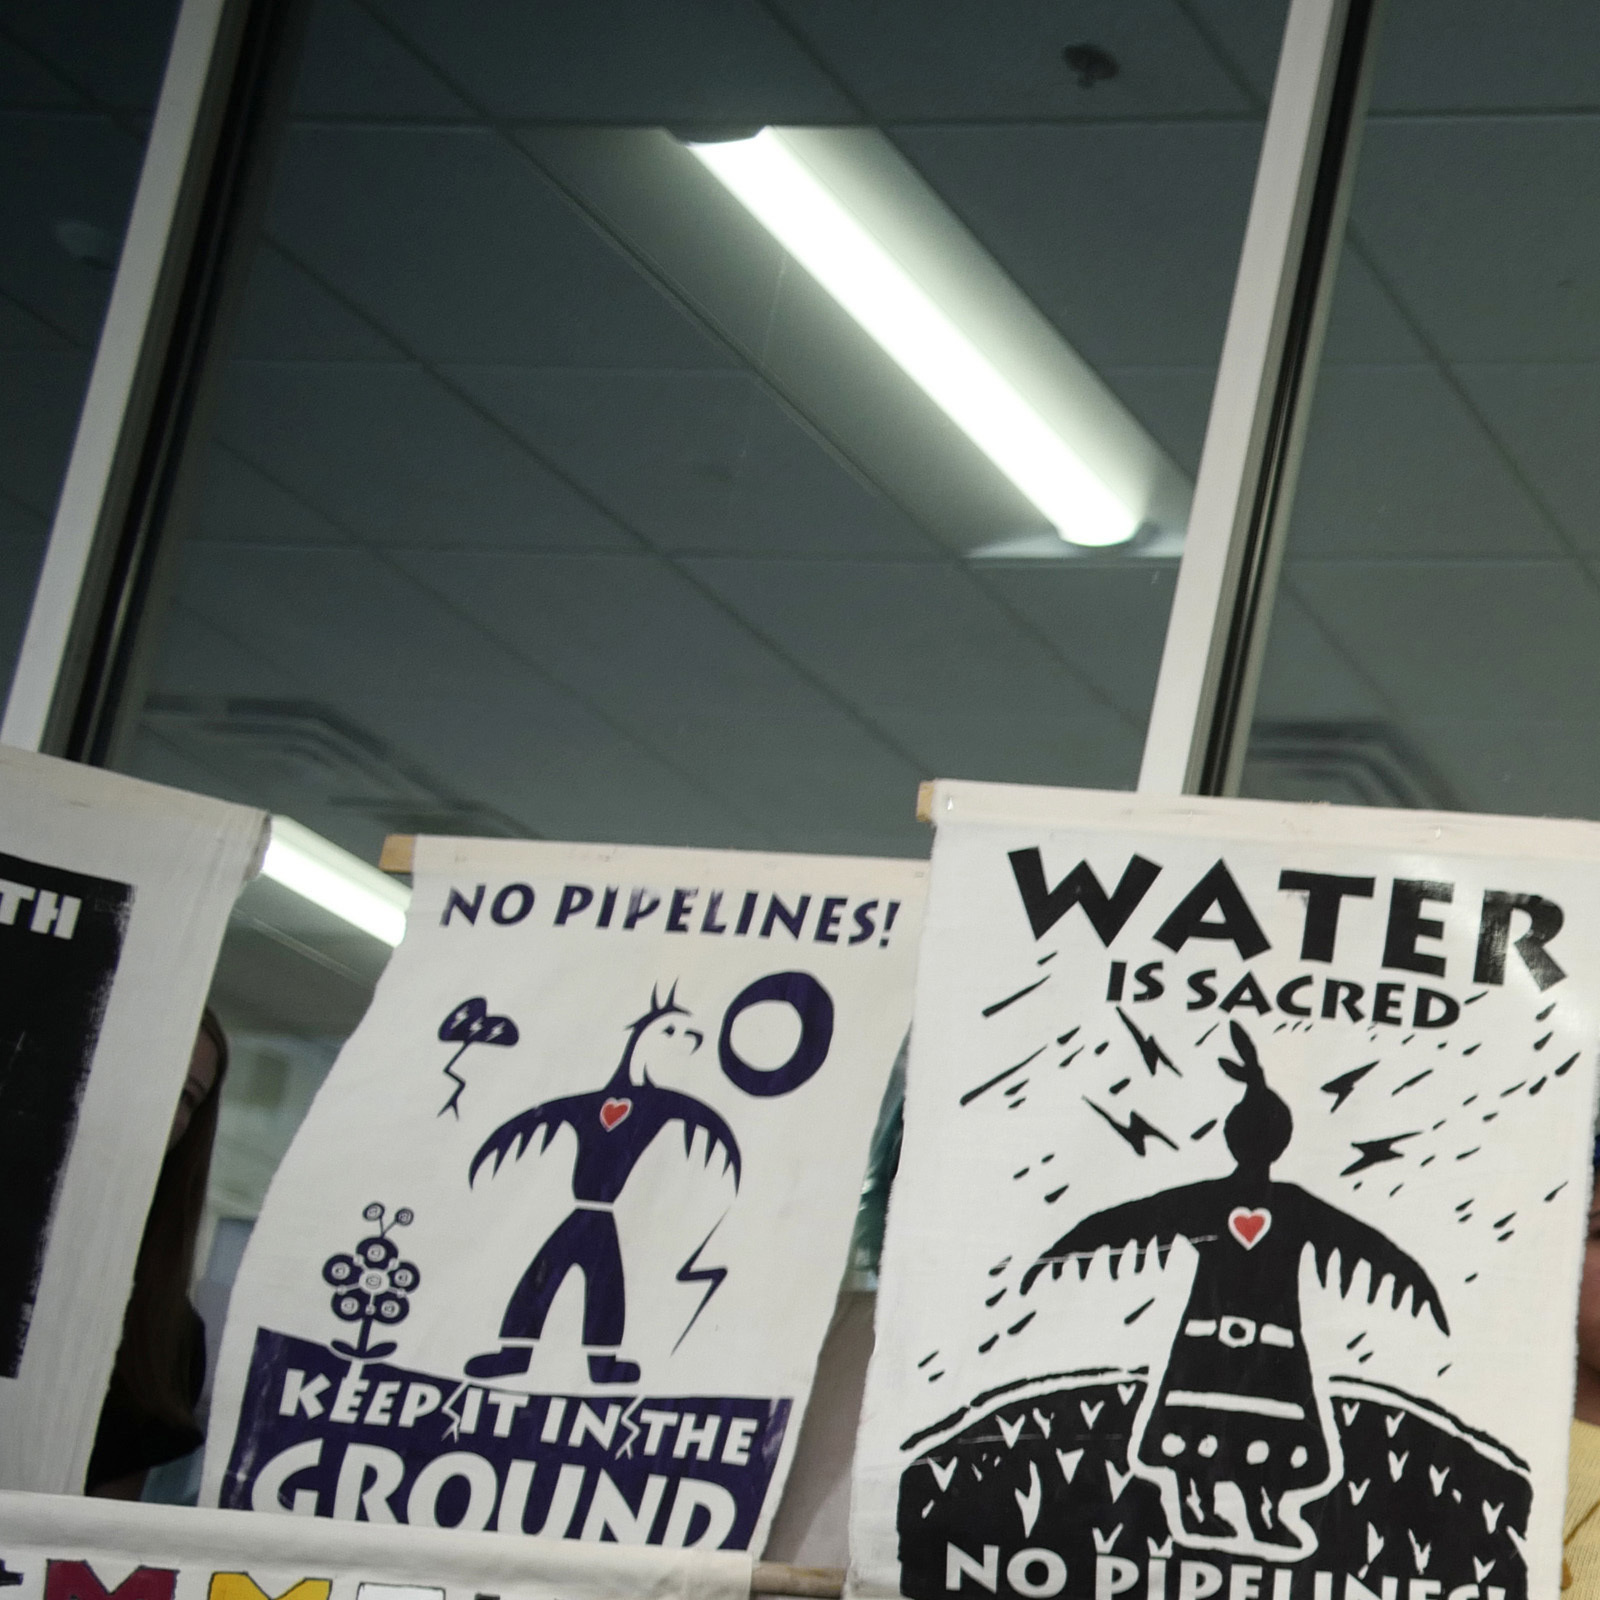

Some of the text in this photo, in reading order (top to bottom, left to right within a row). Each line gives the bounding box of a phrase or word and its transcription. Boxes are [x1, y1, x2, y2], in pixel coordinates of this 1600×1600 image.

[439, 881, 901, 949] NO PIPELINES!
[1007, 846, 1567, 992] WATER
[1106, 960, 1460, 1029] IS SACRED
[278, 1367, 757, 1467] KEEP IT IN THE
[251, 1437, 736, 1550] GROUND
[945, 1541, 1068, 1600] NO
